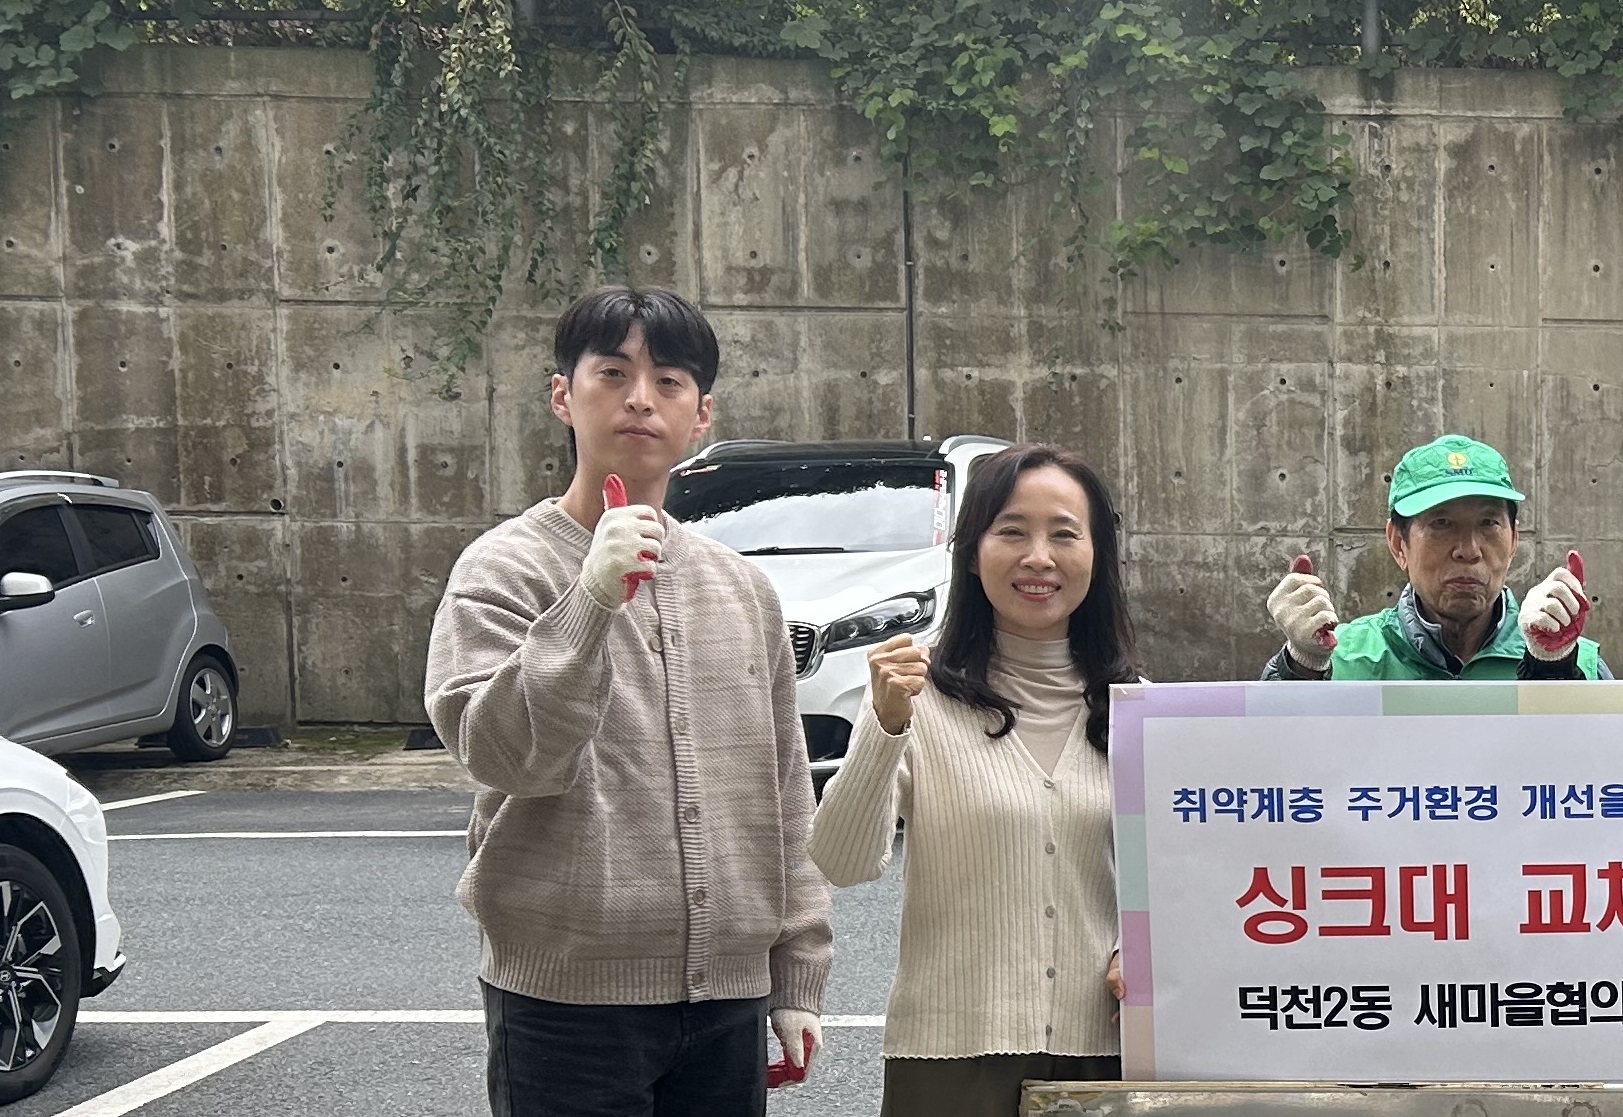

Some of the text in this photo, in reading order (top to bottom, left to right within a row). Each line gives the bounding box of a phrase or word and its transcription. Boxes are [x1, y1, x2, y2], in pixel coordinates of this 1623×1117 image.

[1172, 786, 1324, 824] 취약계층
[1347, 785, 1499, 822] 주거환경
[1235, 863, 1470, 945] 싱크대
[1238, 985, 1393, 1031] 덕천2동
